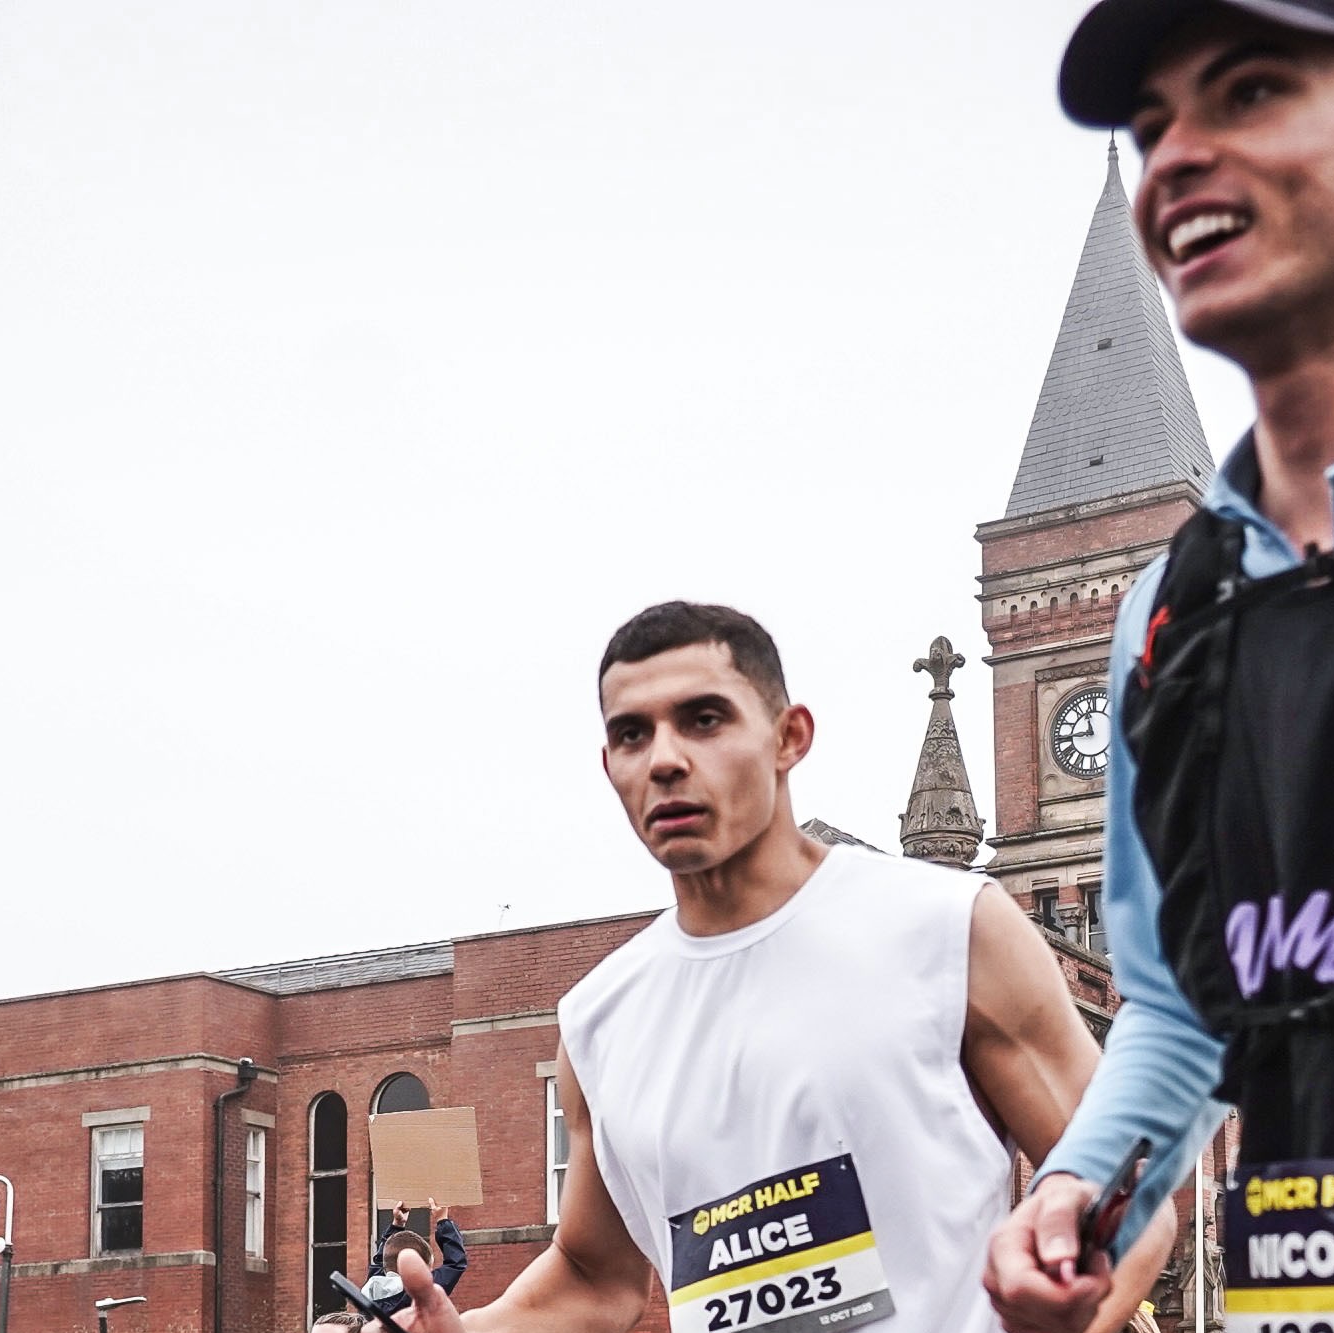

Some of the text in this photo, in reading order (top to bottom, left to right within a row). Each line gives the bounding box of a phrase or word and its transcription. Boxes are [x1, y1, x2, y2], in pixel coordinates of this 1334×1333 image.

[710, 1171, 821, 1227] MCR HALF
[1262, 1176, 1318, 1212] MCR
[708, 1213, 814, 1271] ALICE
[704, 1266, 842, 1333] 27023
